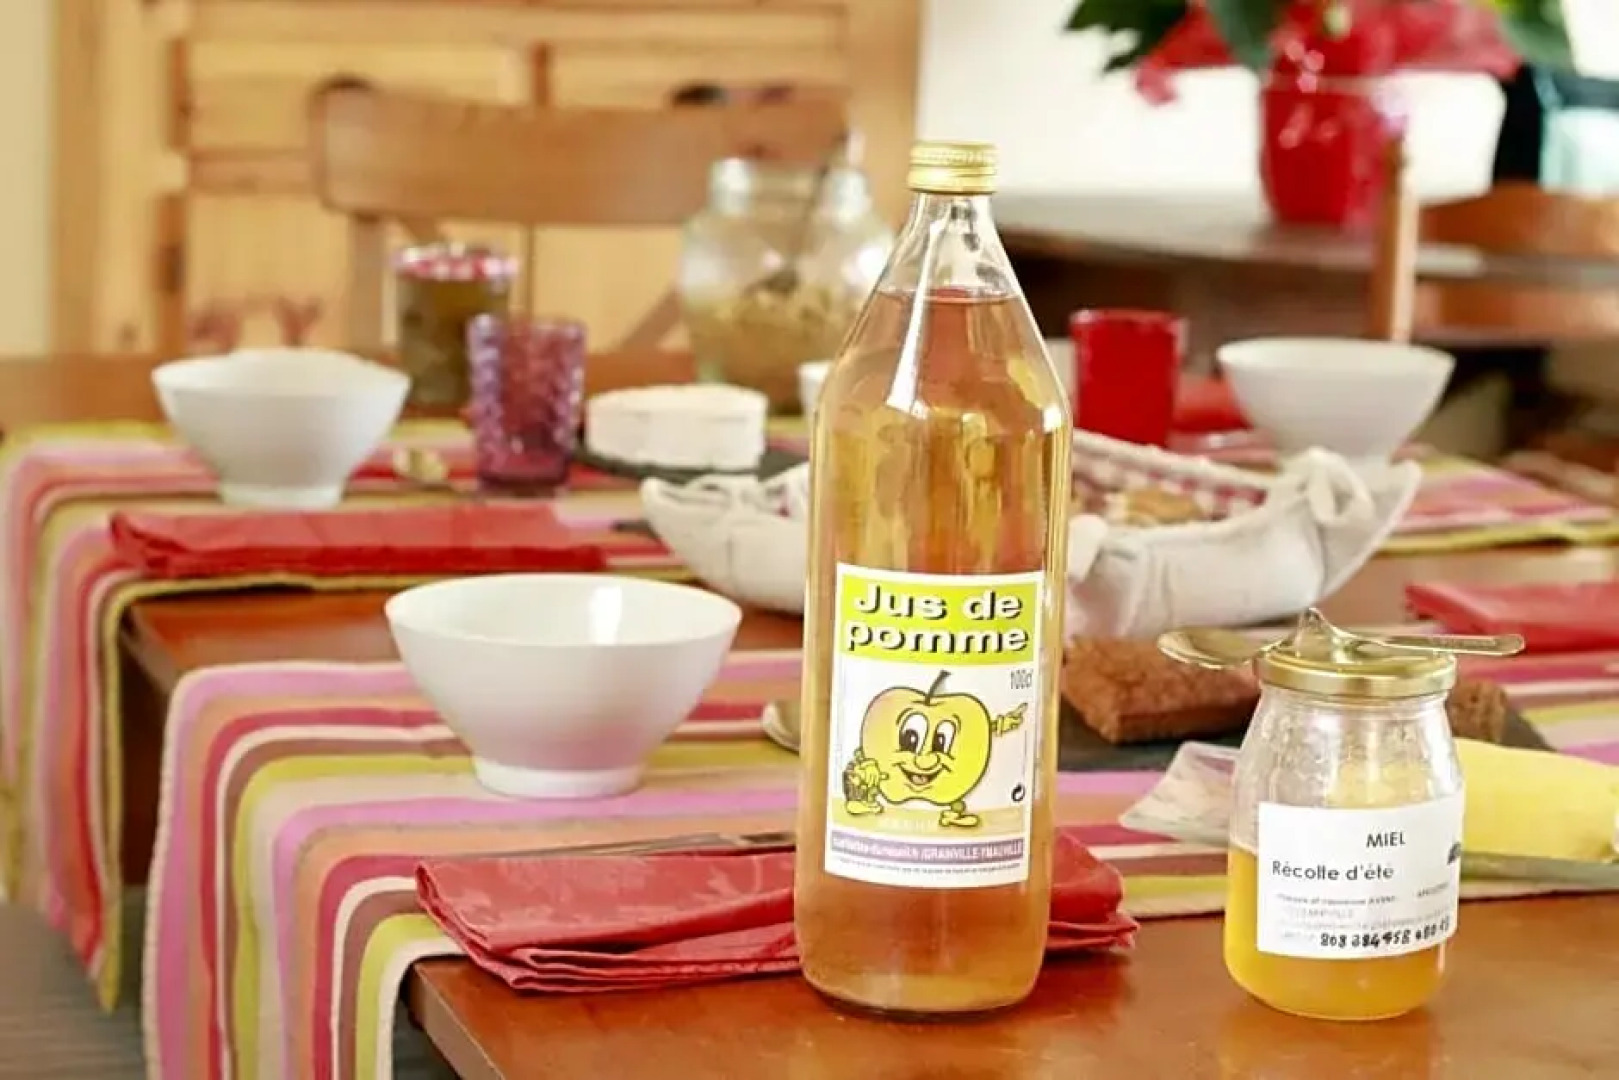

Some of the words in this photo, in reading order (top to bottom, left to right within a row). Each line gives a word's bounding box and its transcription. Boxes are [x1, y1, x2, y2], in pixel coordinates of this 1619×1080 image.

[855, 584, 947, 620] Jus
[963, 587, 1024, 621] de
[846, 620, 1029, 654] pomme
[1366, 831, 1406, 849] MIEL
[1346, 862, 1394, 881] d'été
